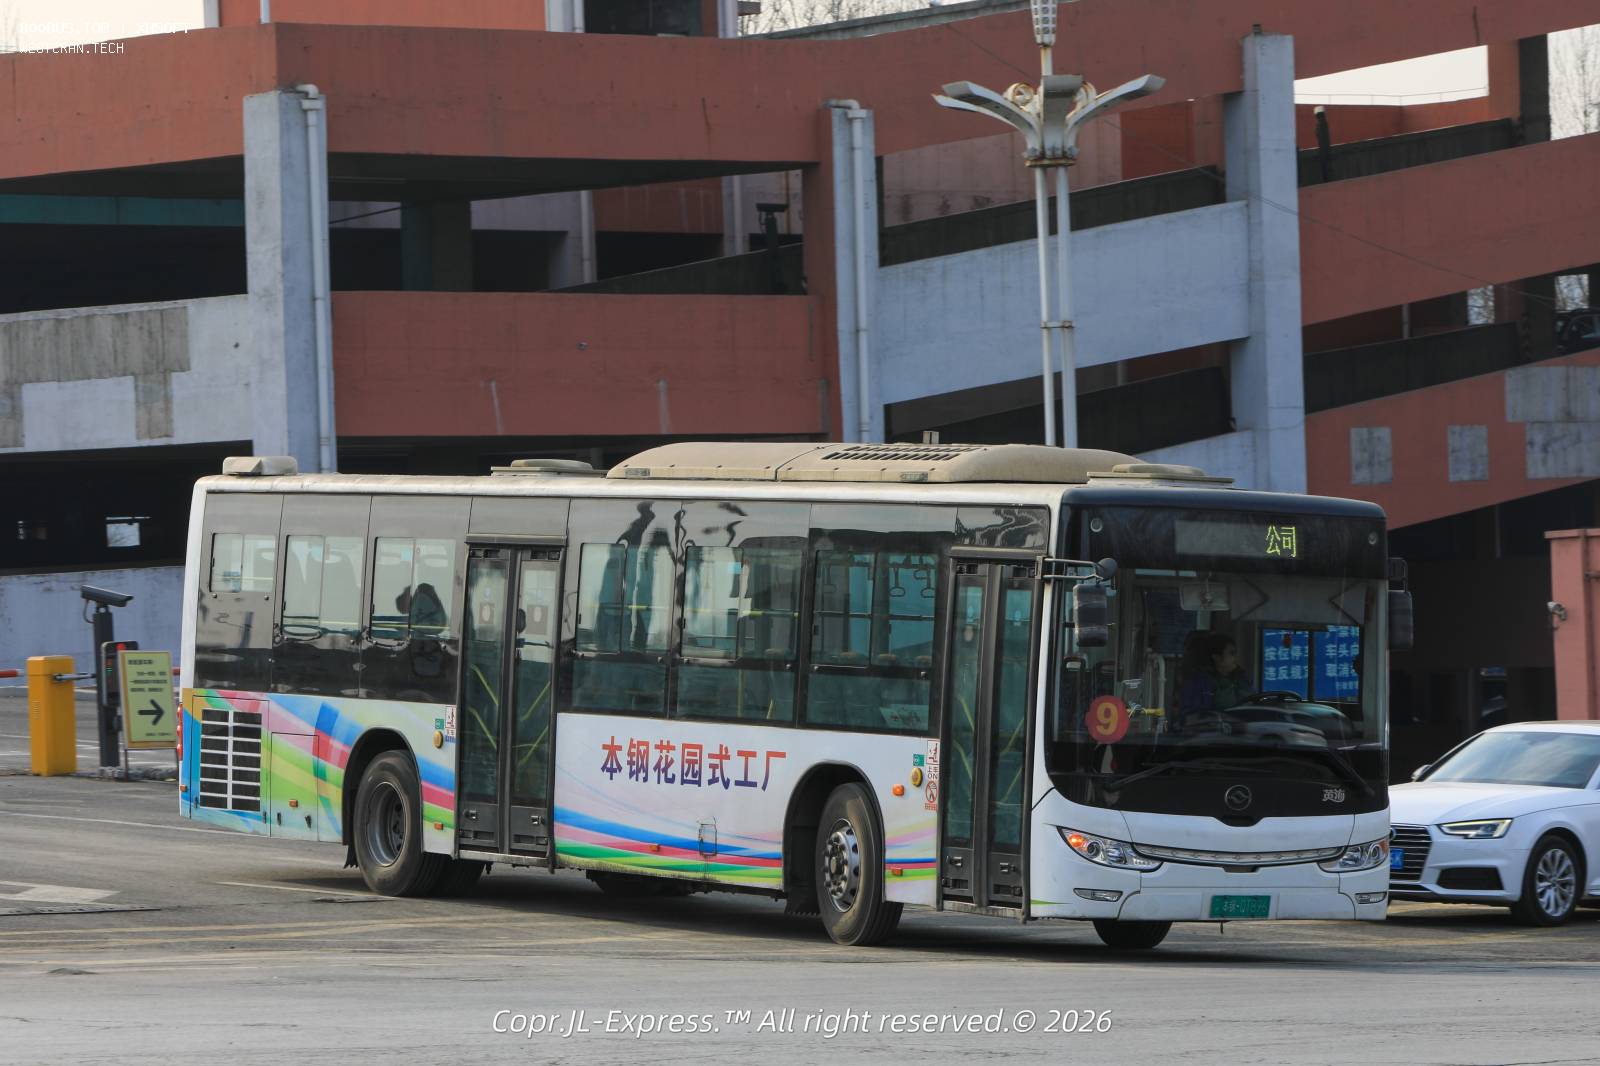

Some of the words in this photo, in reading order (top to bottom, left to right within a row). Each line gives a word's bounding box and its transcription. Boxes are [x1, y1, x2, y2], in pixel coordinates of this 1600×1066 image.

[1265, 524, 1297, 558] 公司
[1096, 702, 1119, 736] 9
[600, 735, 787, 792] 本钢花园式工厂
